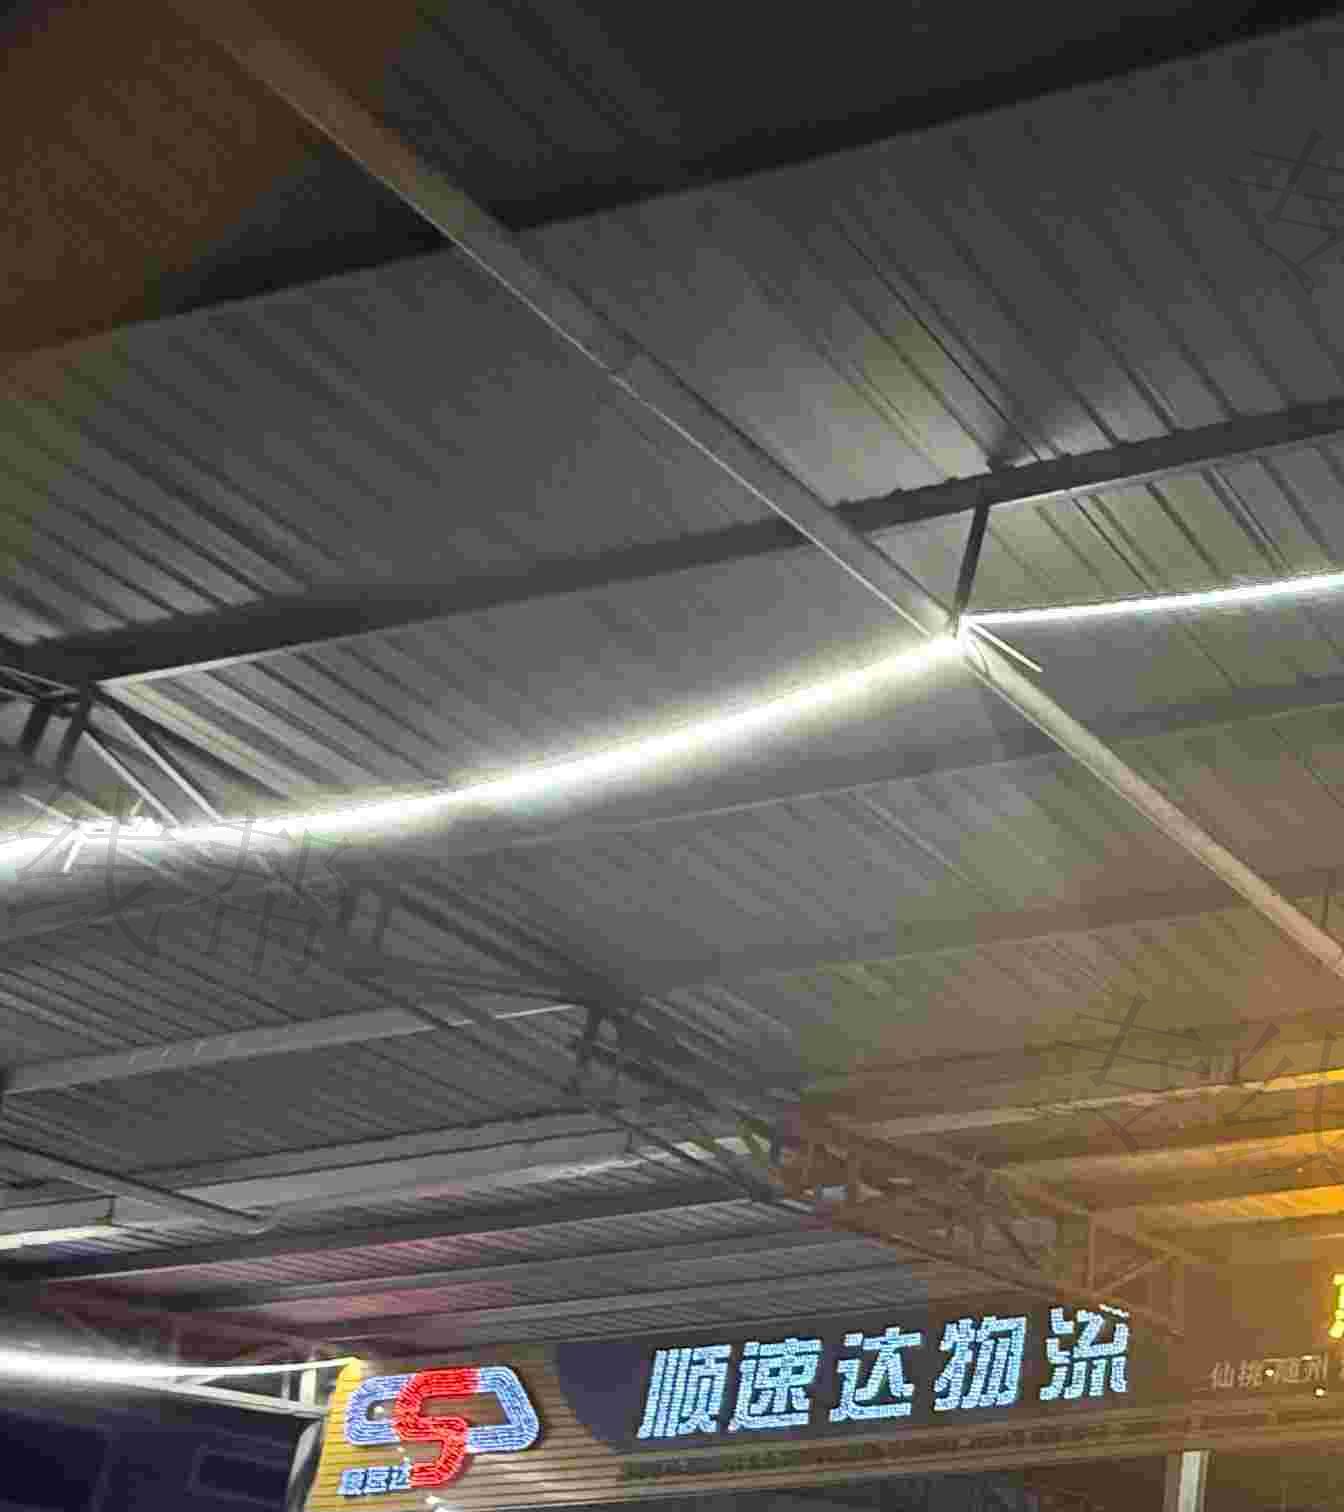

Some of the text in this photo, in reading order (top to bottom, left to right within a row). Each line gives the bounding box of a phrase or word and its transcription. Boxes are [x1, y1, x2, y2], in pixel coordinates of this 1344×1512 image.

[637, 1303, 1131, 1440] 顺速达物流
